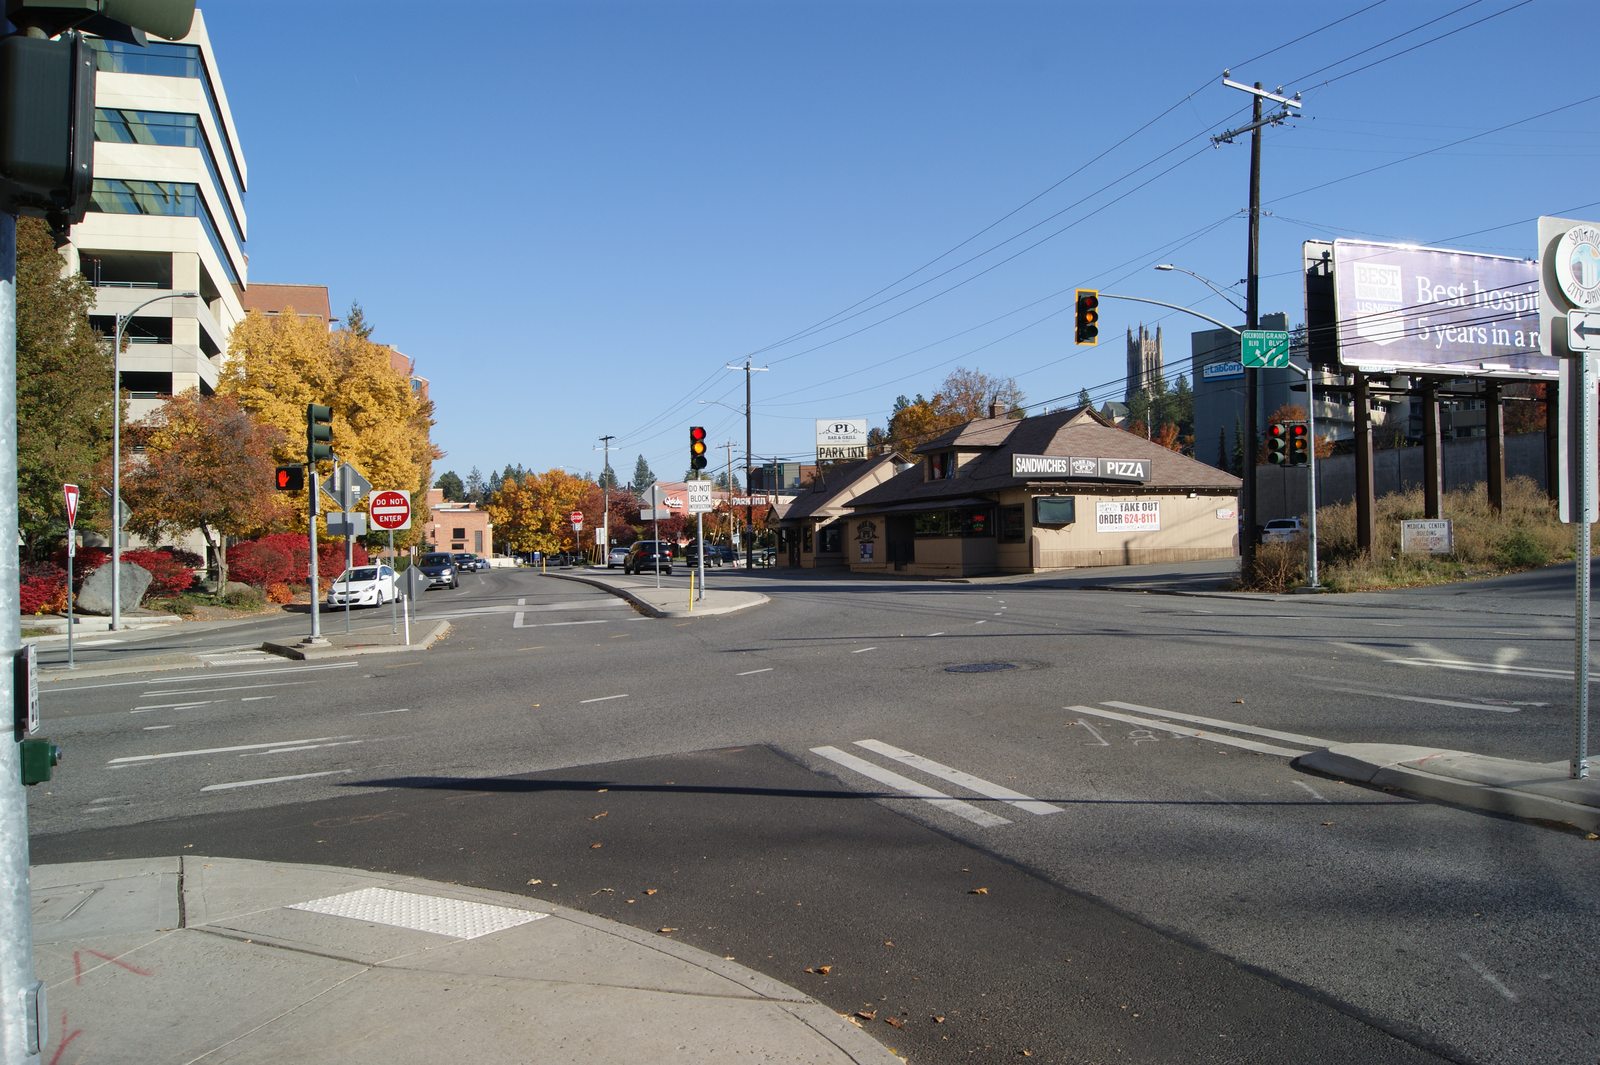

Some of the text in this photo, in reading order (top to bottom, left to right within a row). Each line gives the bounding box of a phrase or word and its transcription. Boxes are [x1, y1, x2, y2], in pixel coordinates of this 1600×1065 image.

[1357, 265, 1398, 286] BEST
[1416, 275, 1469, 306] Best
[1567, 282, 1583, 302] CITY
[1418, 317, 1430, 341] 5
[1435, 321, 1487, 349] years
[1492, 321, 1510, 346] in
[1514, 330, 1526, 347] a
[1210, 363, 1242, 374] LabCorp
[835, 424, 848, 433] PI
[820, 446, 864, 458] PARK INN
[1016, 457, 1067, 473] SANDWICHES
[1106, 461, 1145, 478] PIZZA
[689, 484, 710, 492] DO NOT
[732, 497, 766, 506] PARK INN
[1120, 502, 1140, 512] TAKE
[1142, 502, 1158, 512] OUT
[1099, 513, 1157, 525] ORDER 624-8111
